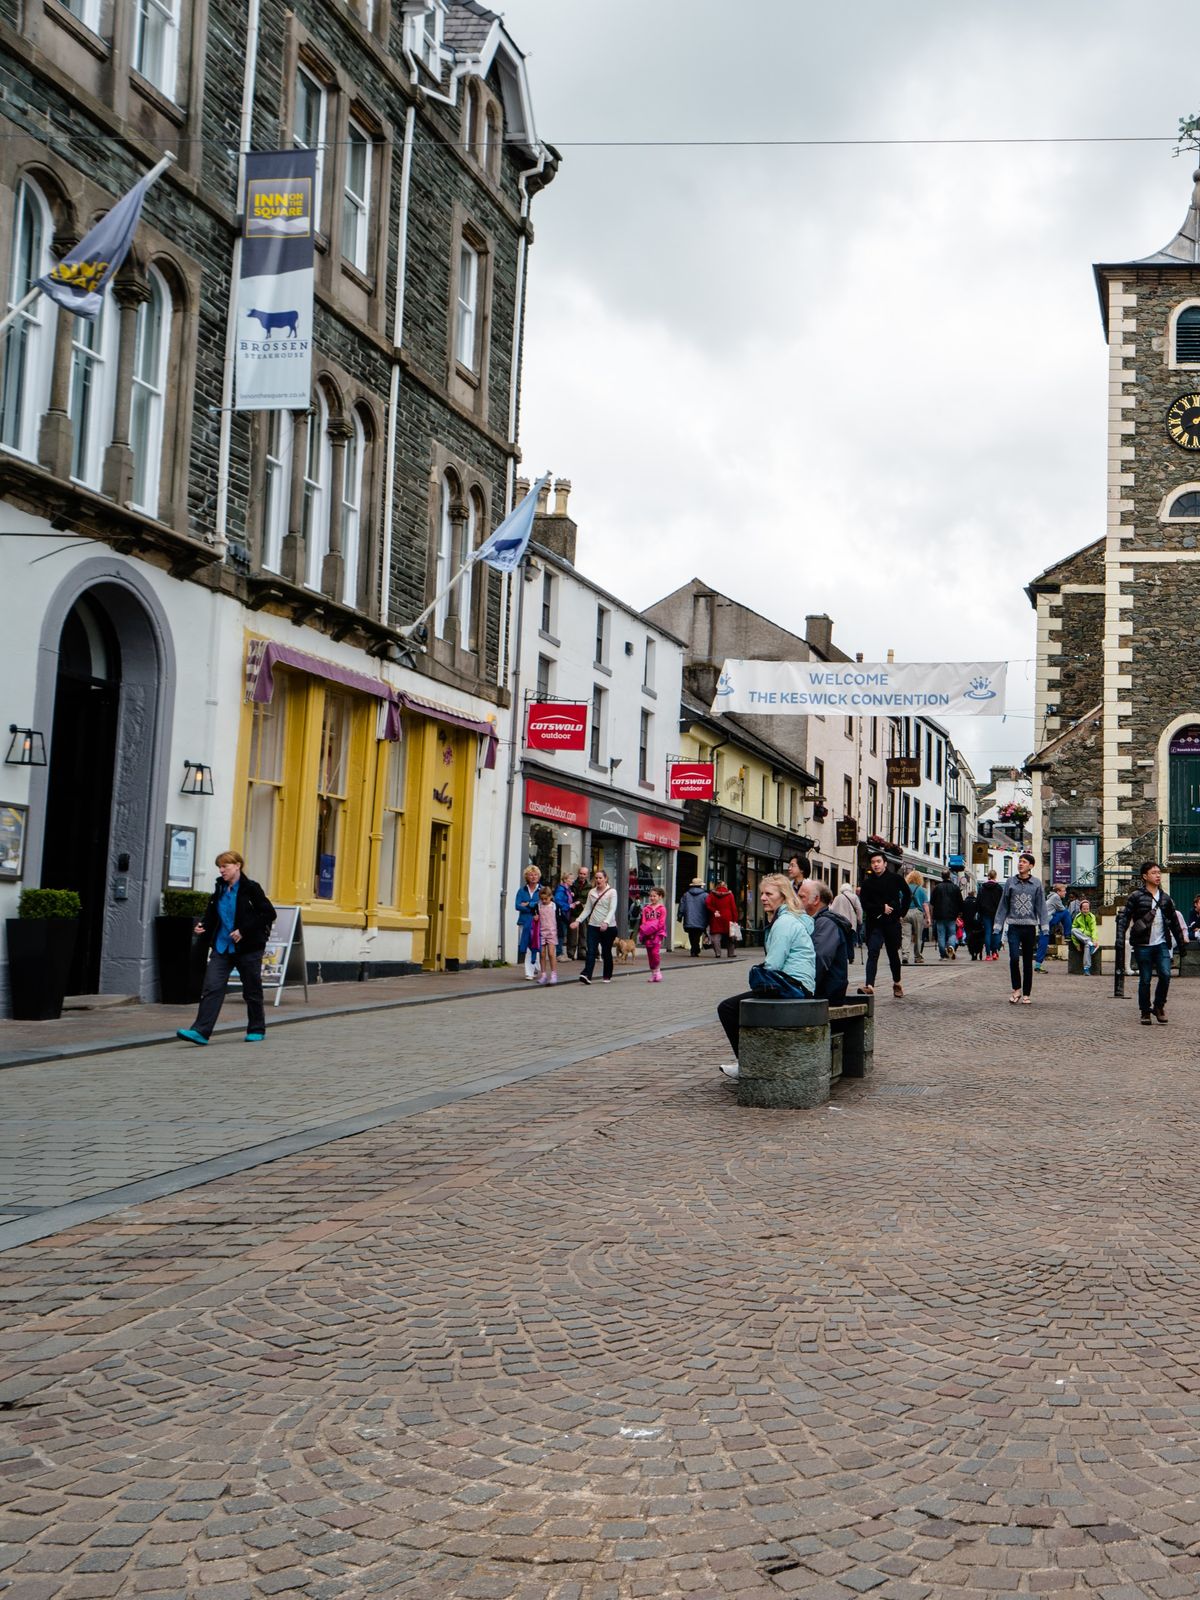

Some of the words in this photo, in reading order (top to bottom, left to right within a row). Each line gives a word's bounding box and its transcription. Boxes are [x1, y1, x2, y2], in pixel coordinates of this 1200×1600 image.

[254, 193, 289, 207] INN
[254, 207, 303, 219] SQUARE
[240, 342, 308, 351] BROSSEN
[809, 673, 889, 686] WELCOME
[749, 691, 777, 704] THE
[780, 692, 848, 705] KESWICK
[851, 694, 949, 706] CONVENTION
[530, 722, 583, 732] COTSWOLD
[600, 818, 628, 836] COTSWOLD
